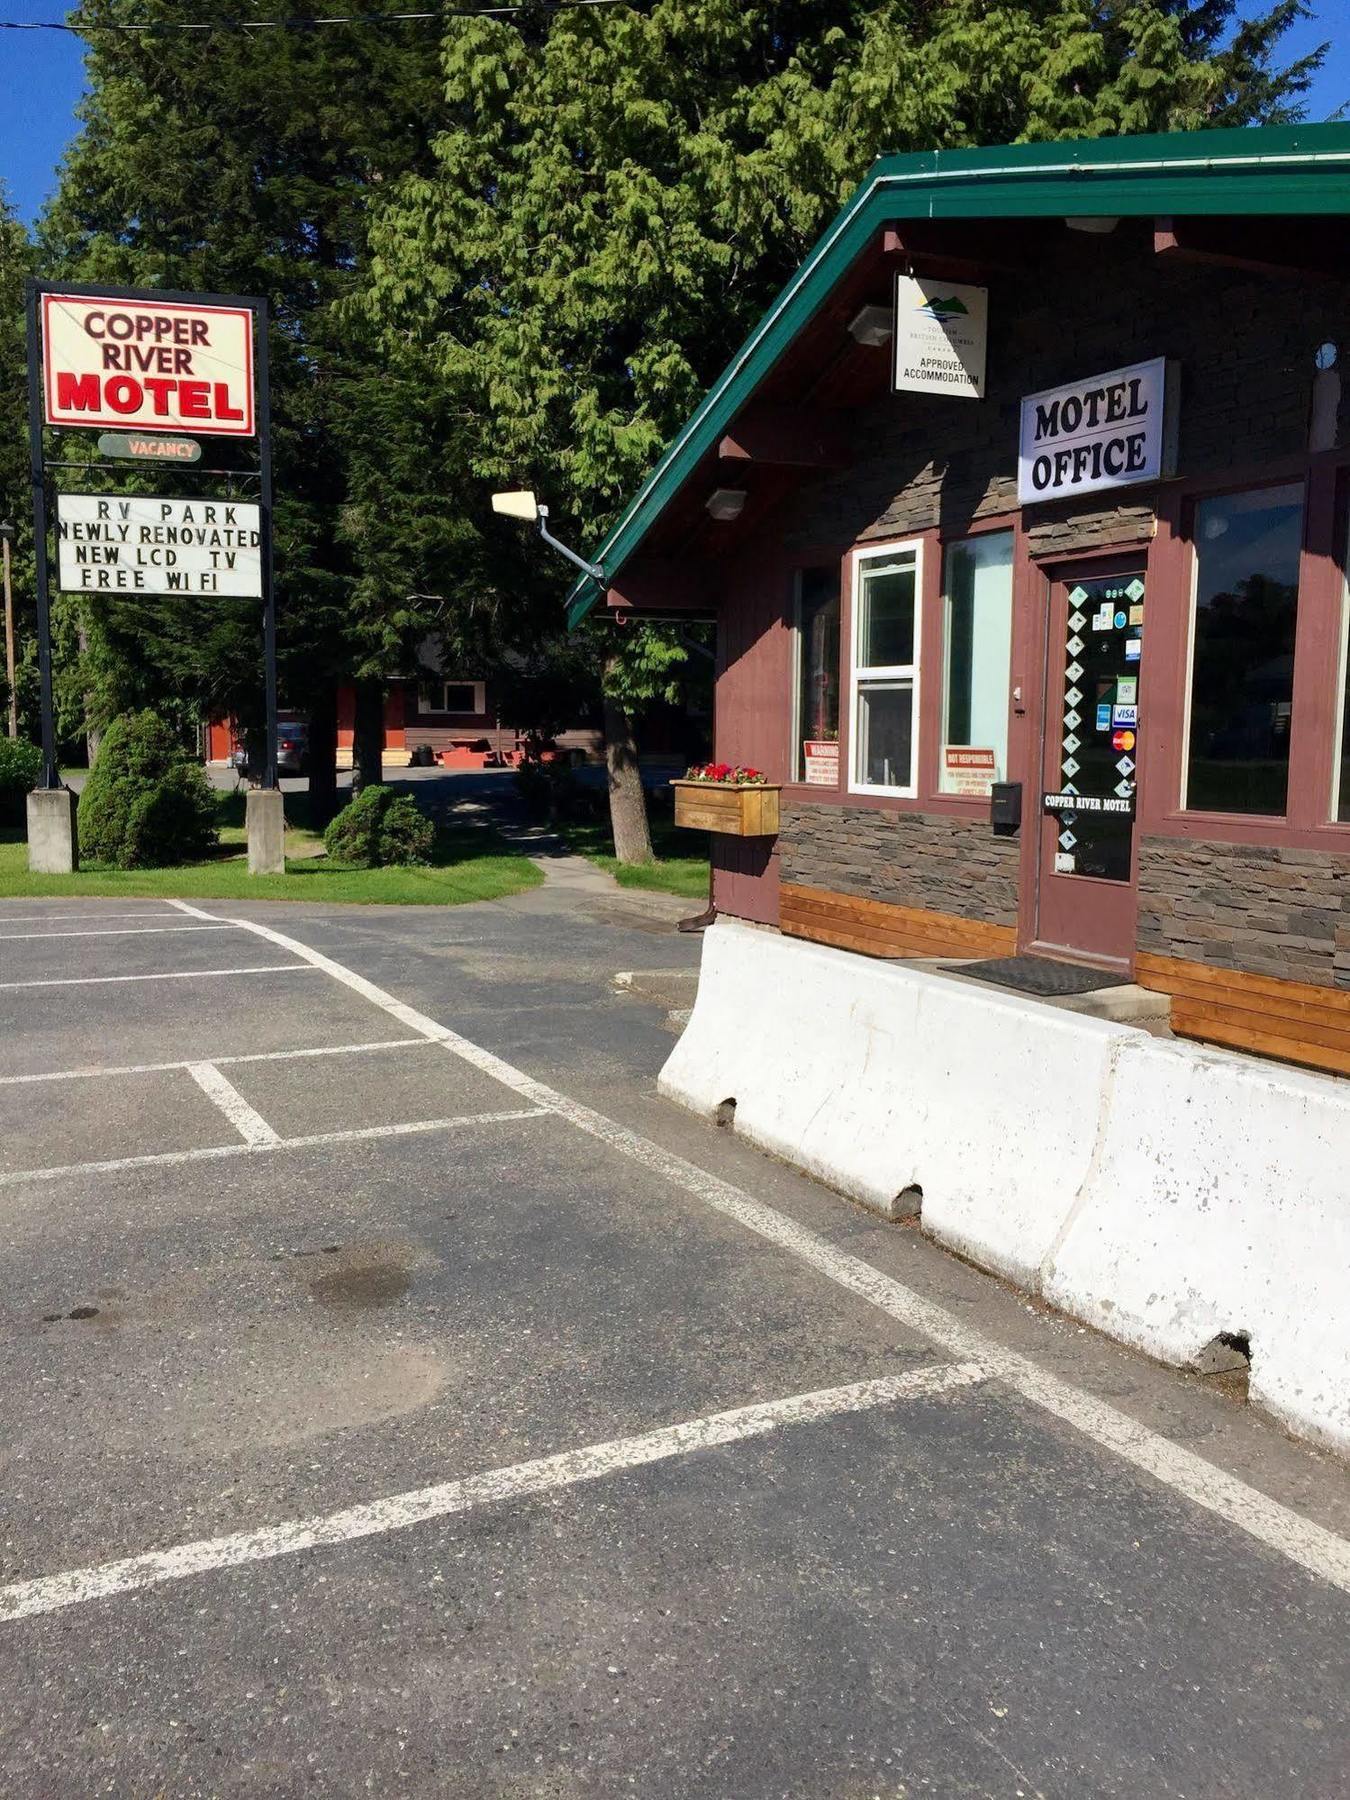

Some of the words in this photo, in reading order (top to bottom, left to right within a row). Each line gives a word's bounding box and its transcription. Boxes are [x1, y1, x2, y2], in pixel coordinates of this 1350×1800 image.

[84, 311, 212, 347] COPPER
[102, 343, 195, 376] RIVER
[920, 357, 963, 371] APPROVED
[904, 368, 979, 384] ACCOMMODATION
[57, 372, 244, 421] MOTEL
[1034, 378, 1148, 441] MOTEL
[128, 440, 195, 458] VACANCY
[1032, 432, 1146, 490] OFFICE
[160, 504, 237, 525] PARK
[57, 521, 130, 543] NEWLY
[140, 525, 261, 548] RENOVATED
[75, 545, 119, 564] NEW
[137, 547, 176, 567] LCD
[209, 551, 237, 569] TV
[81, 568, 145, 588] FREE
[1117, 708, 1135, 719] VISA
[1045, 795, 1075, 808] COPPER
[1076, 797, 1102, 810] RIVER
[1103, 799, 1131, 812] MOTEL
